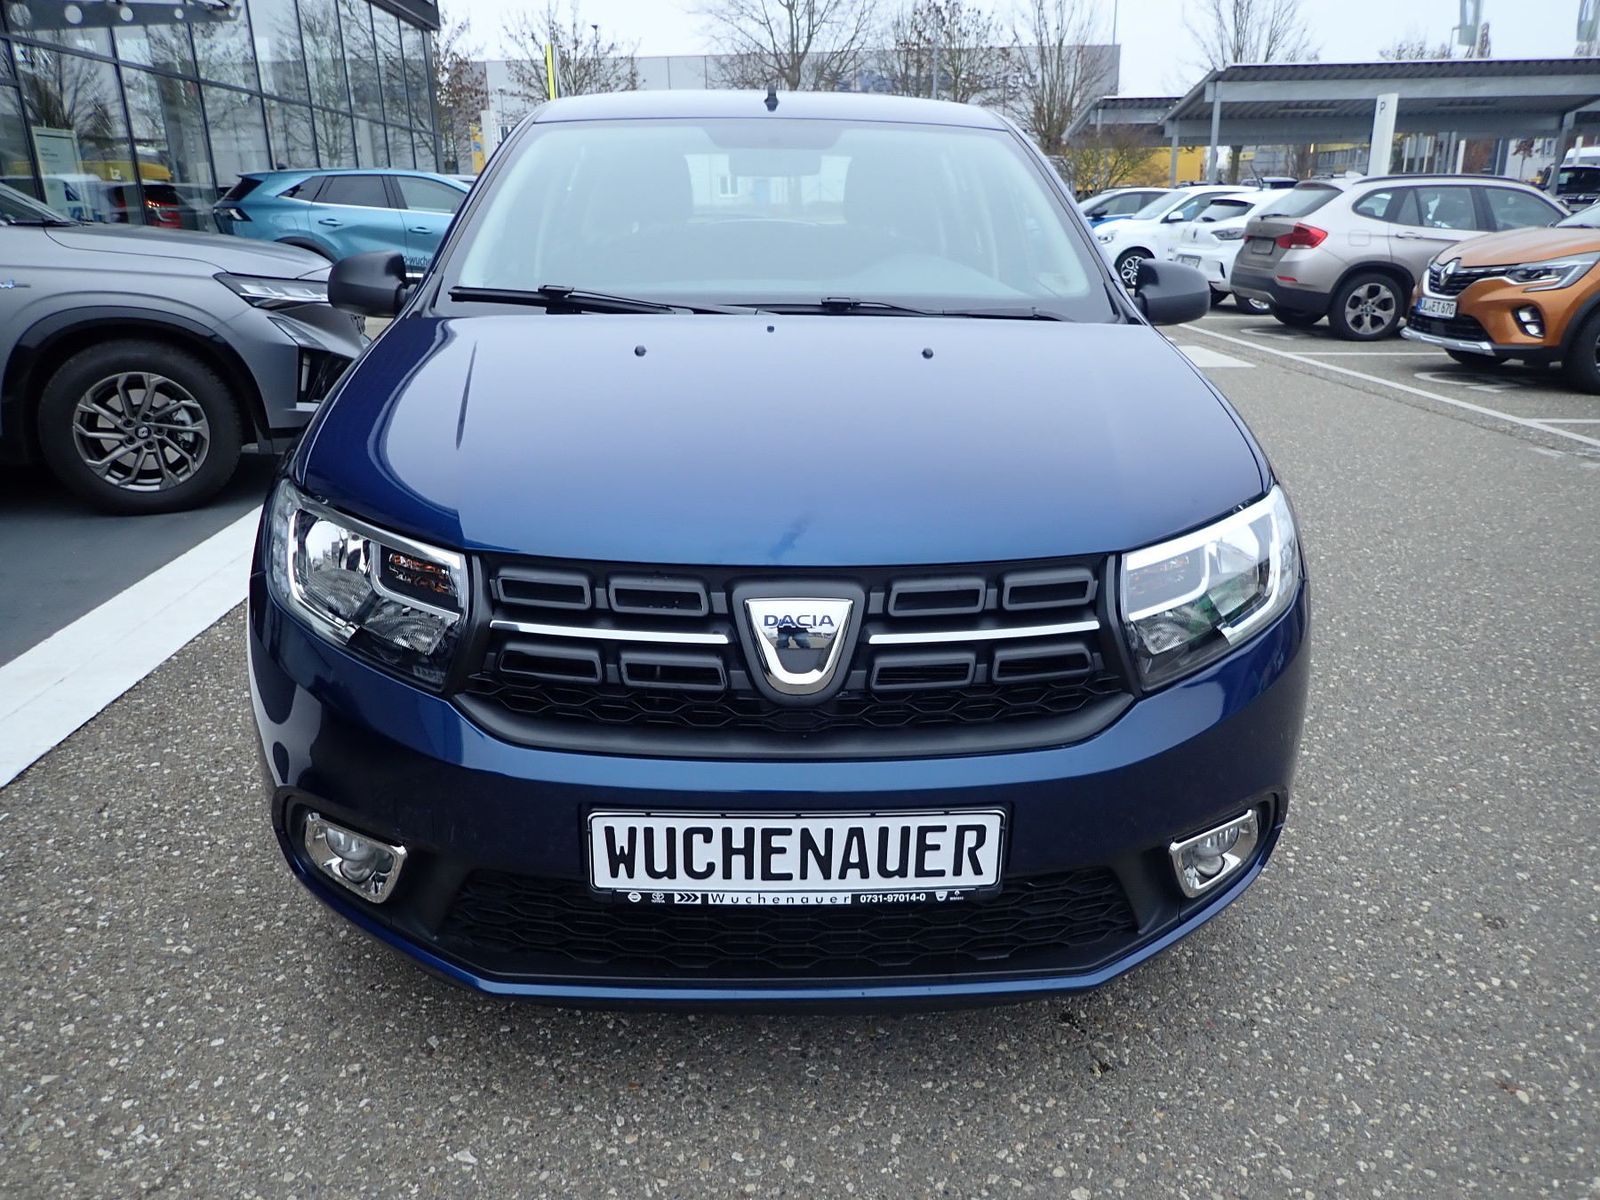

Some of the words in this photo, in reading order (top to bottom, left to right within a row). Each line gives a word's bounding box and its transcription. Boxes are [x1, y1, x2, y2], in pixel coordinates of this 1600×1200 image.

[1379, 101, 1386, 115] P
[764, 614, 834, 628] DACIA
[604, 824, 987, 881] WUCHENAUER
[710, 893, 850, 904] Wuchenauer
[859, 893, 926, 903] 0731-97014-0
